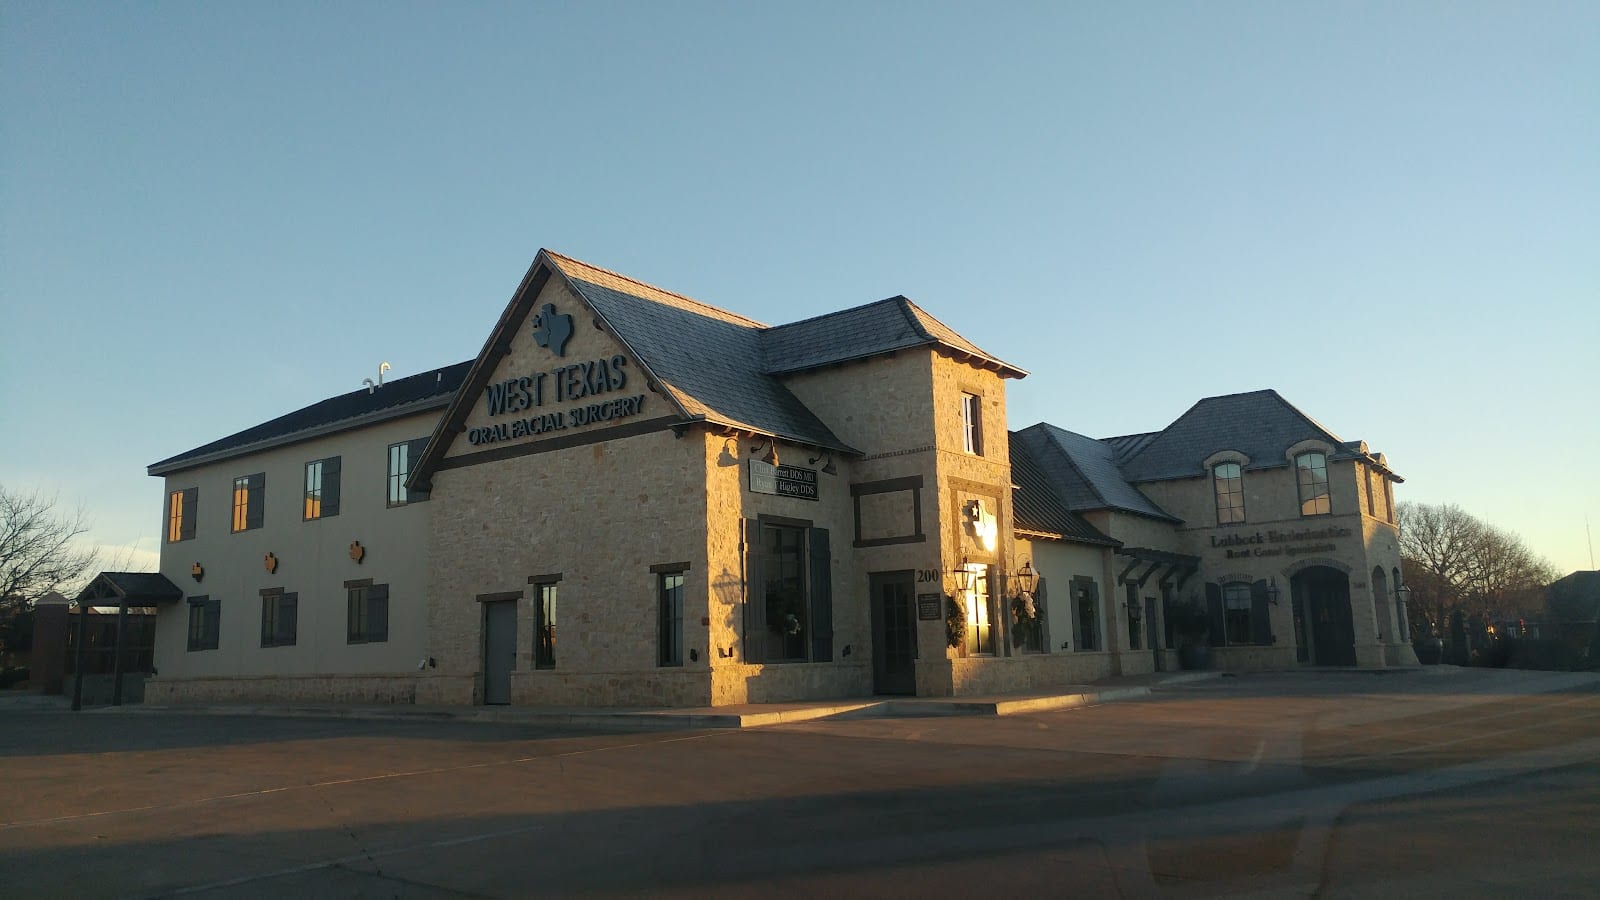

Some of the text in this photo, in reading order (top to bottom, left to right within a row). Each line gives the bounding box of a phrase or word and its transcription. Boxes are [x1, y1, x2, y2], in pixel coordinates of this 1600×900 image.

[486, 355, 627, 416] WEST TEXAS
[468, 394, 646, 445] ORAL FACIAL SURGERY
[790, 470, 803, 480] DDS
[779, 480, 799, 494] Higley
[800, 484, 815, 495] DDS
[1210, 532, 1264, 548] Lubbock
[1226, 546, 1250, 559] Root
[917, 568, 939, 583] 200
